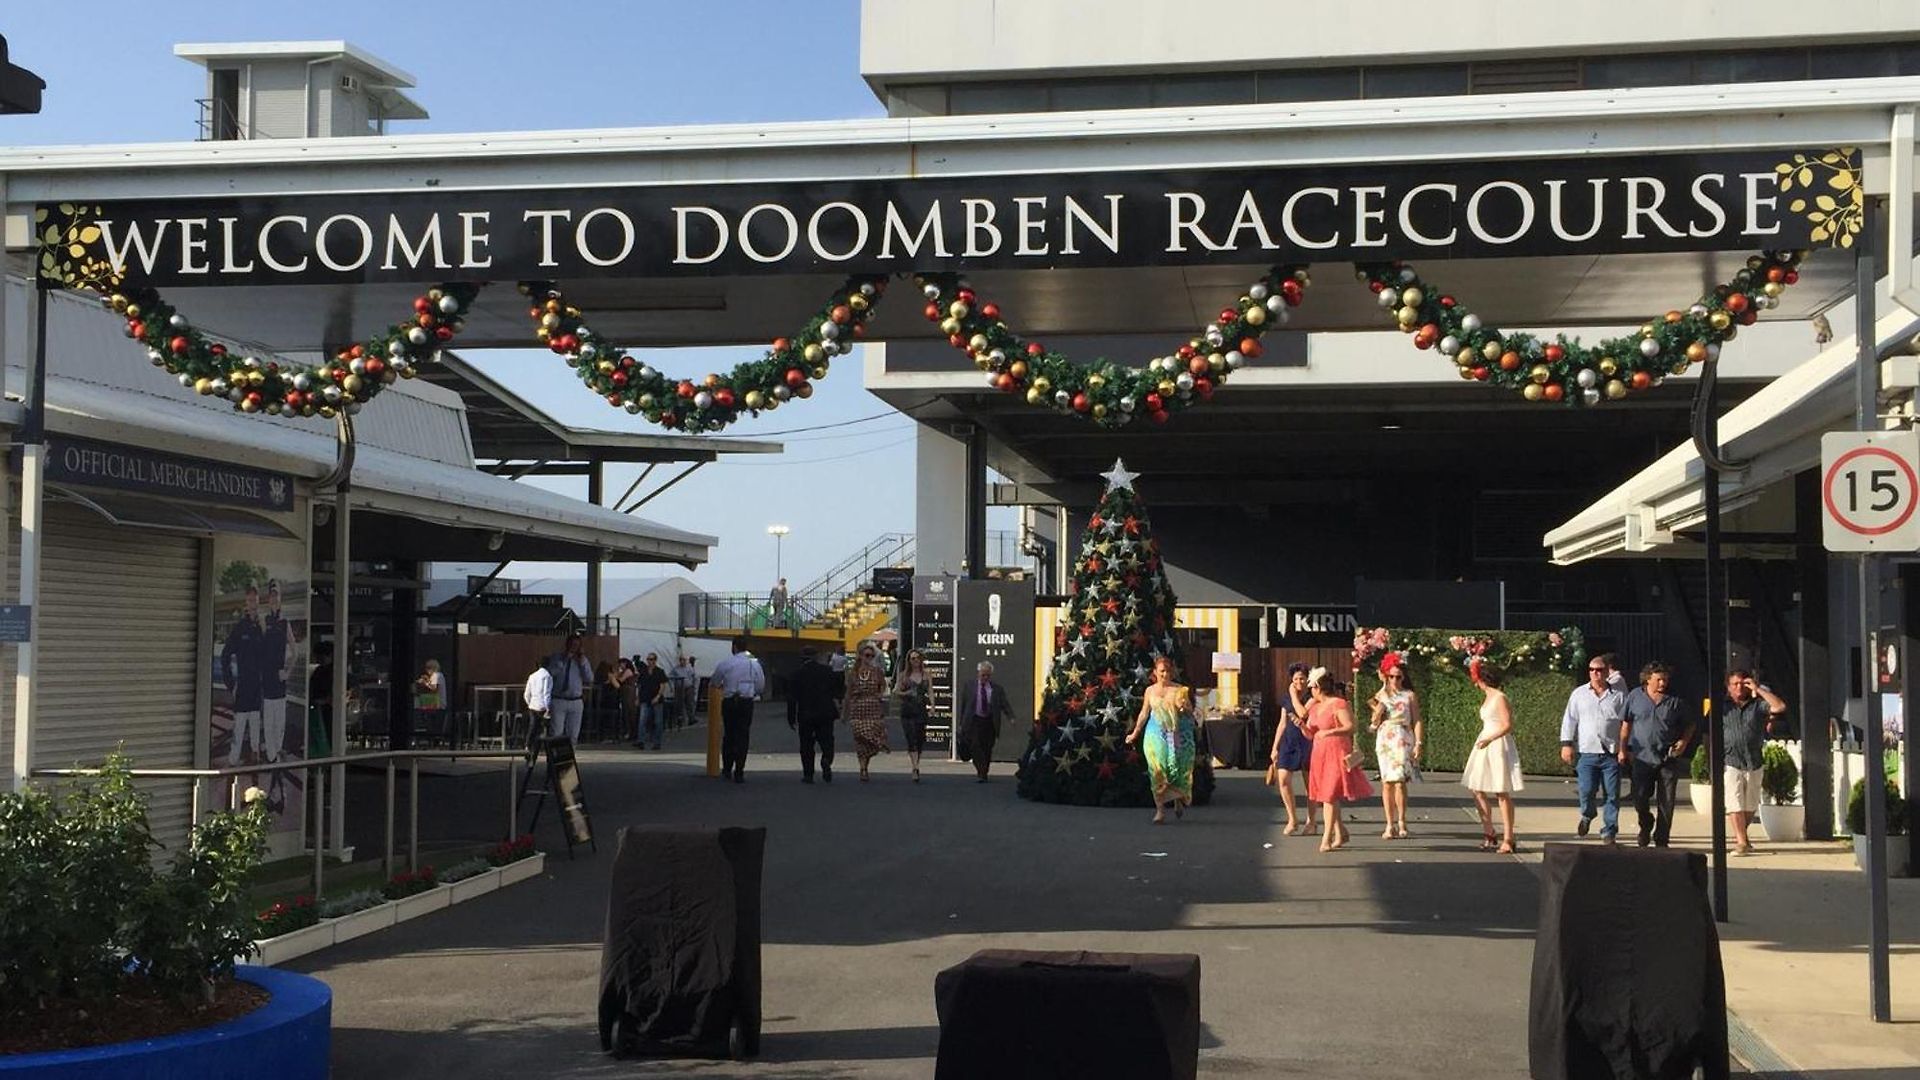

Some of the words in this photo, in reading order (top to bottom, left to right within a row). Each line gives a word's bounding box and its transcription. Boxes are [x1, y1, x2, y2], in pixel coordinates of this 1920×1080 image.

[97, 210, 493, 276] WELCOME
[523, 207, 636, 268] TO
[671, 194, 1124, 265] DOOMBEN
[1164, 172, 1782, 253] RACECOURSE
[64, 446, 147, 482] OFFICIAL
[150, 462, 261, 499] MERCHANDISE
[1845, 469, 1900, 512] 15
[977, 633, 1015, 645] KIRIN
[1295, 613, 1358, 633] KIRIN
